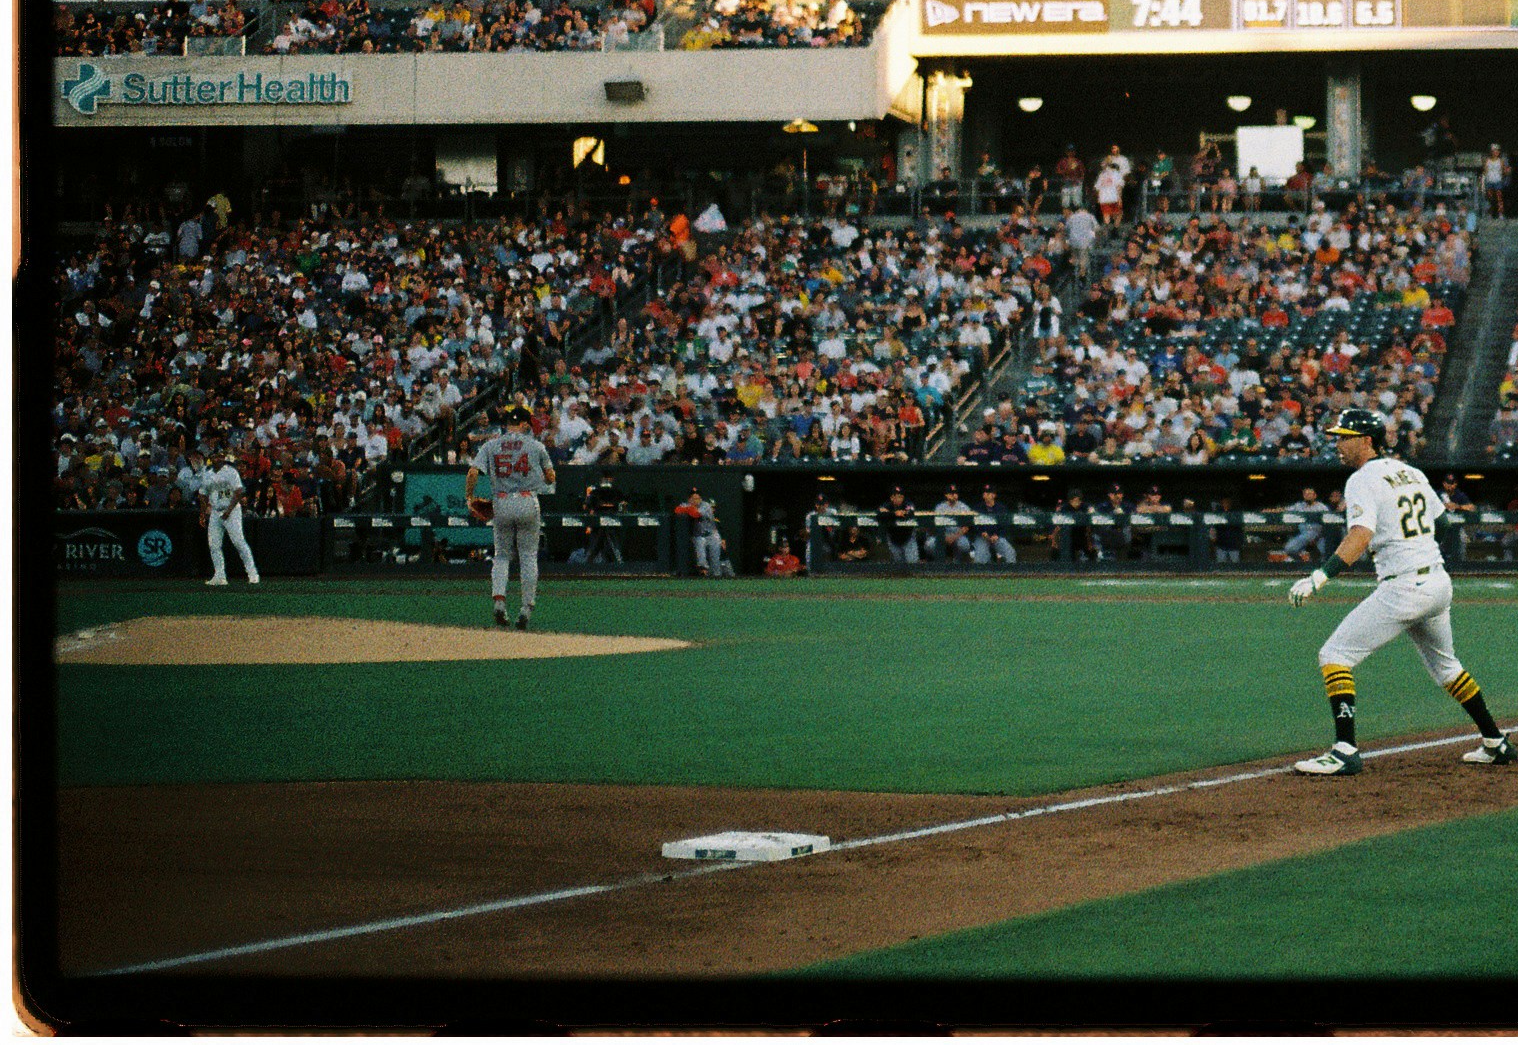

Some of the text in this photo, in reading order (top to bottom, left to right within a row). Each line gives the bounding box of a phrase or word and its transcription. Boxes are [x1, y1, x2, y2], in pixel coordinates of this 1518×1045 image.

[123, 72, 350, 103] Sutter Health
[493, 452, 532, 478] 54
[1398, 491, 1431, 538] 22
[66, 543, 125, 561] RIVER
